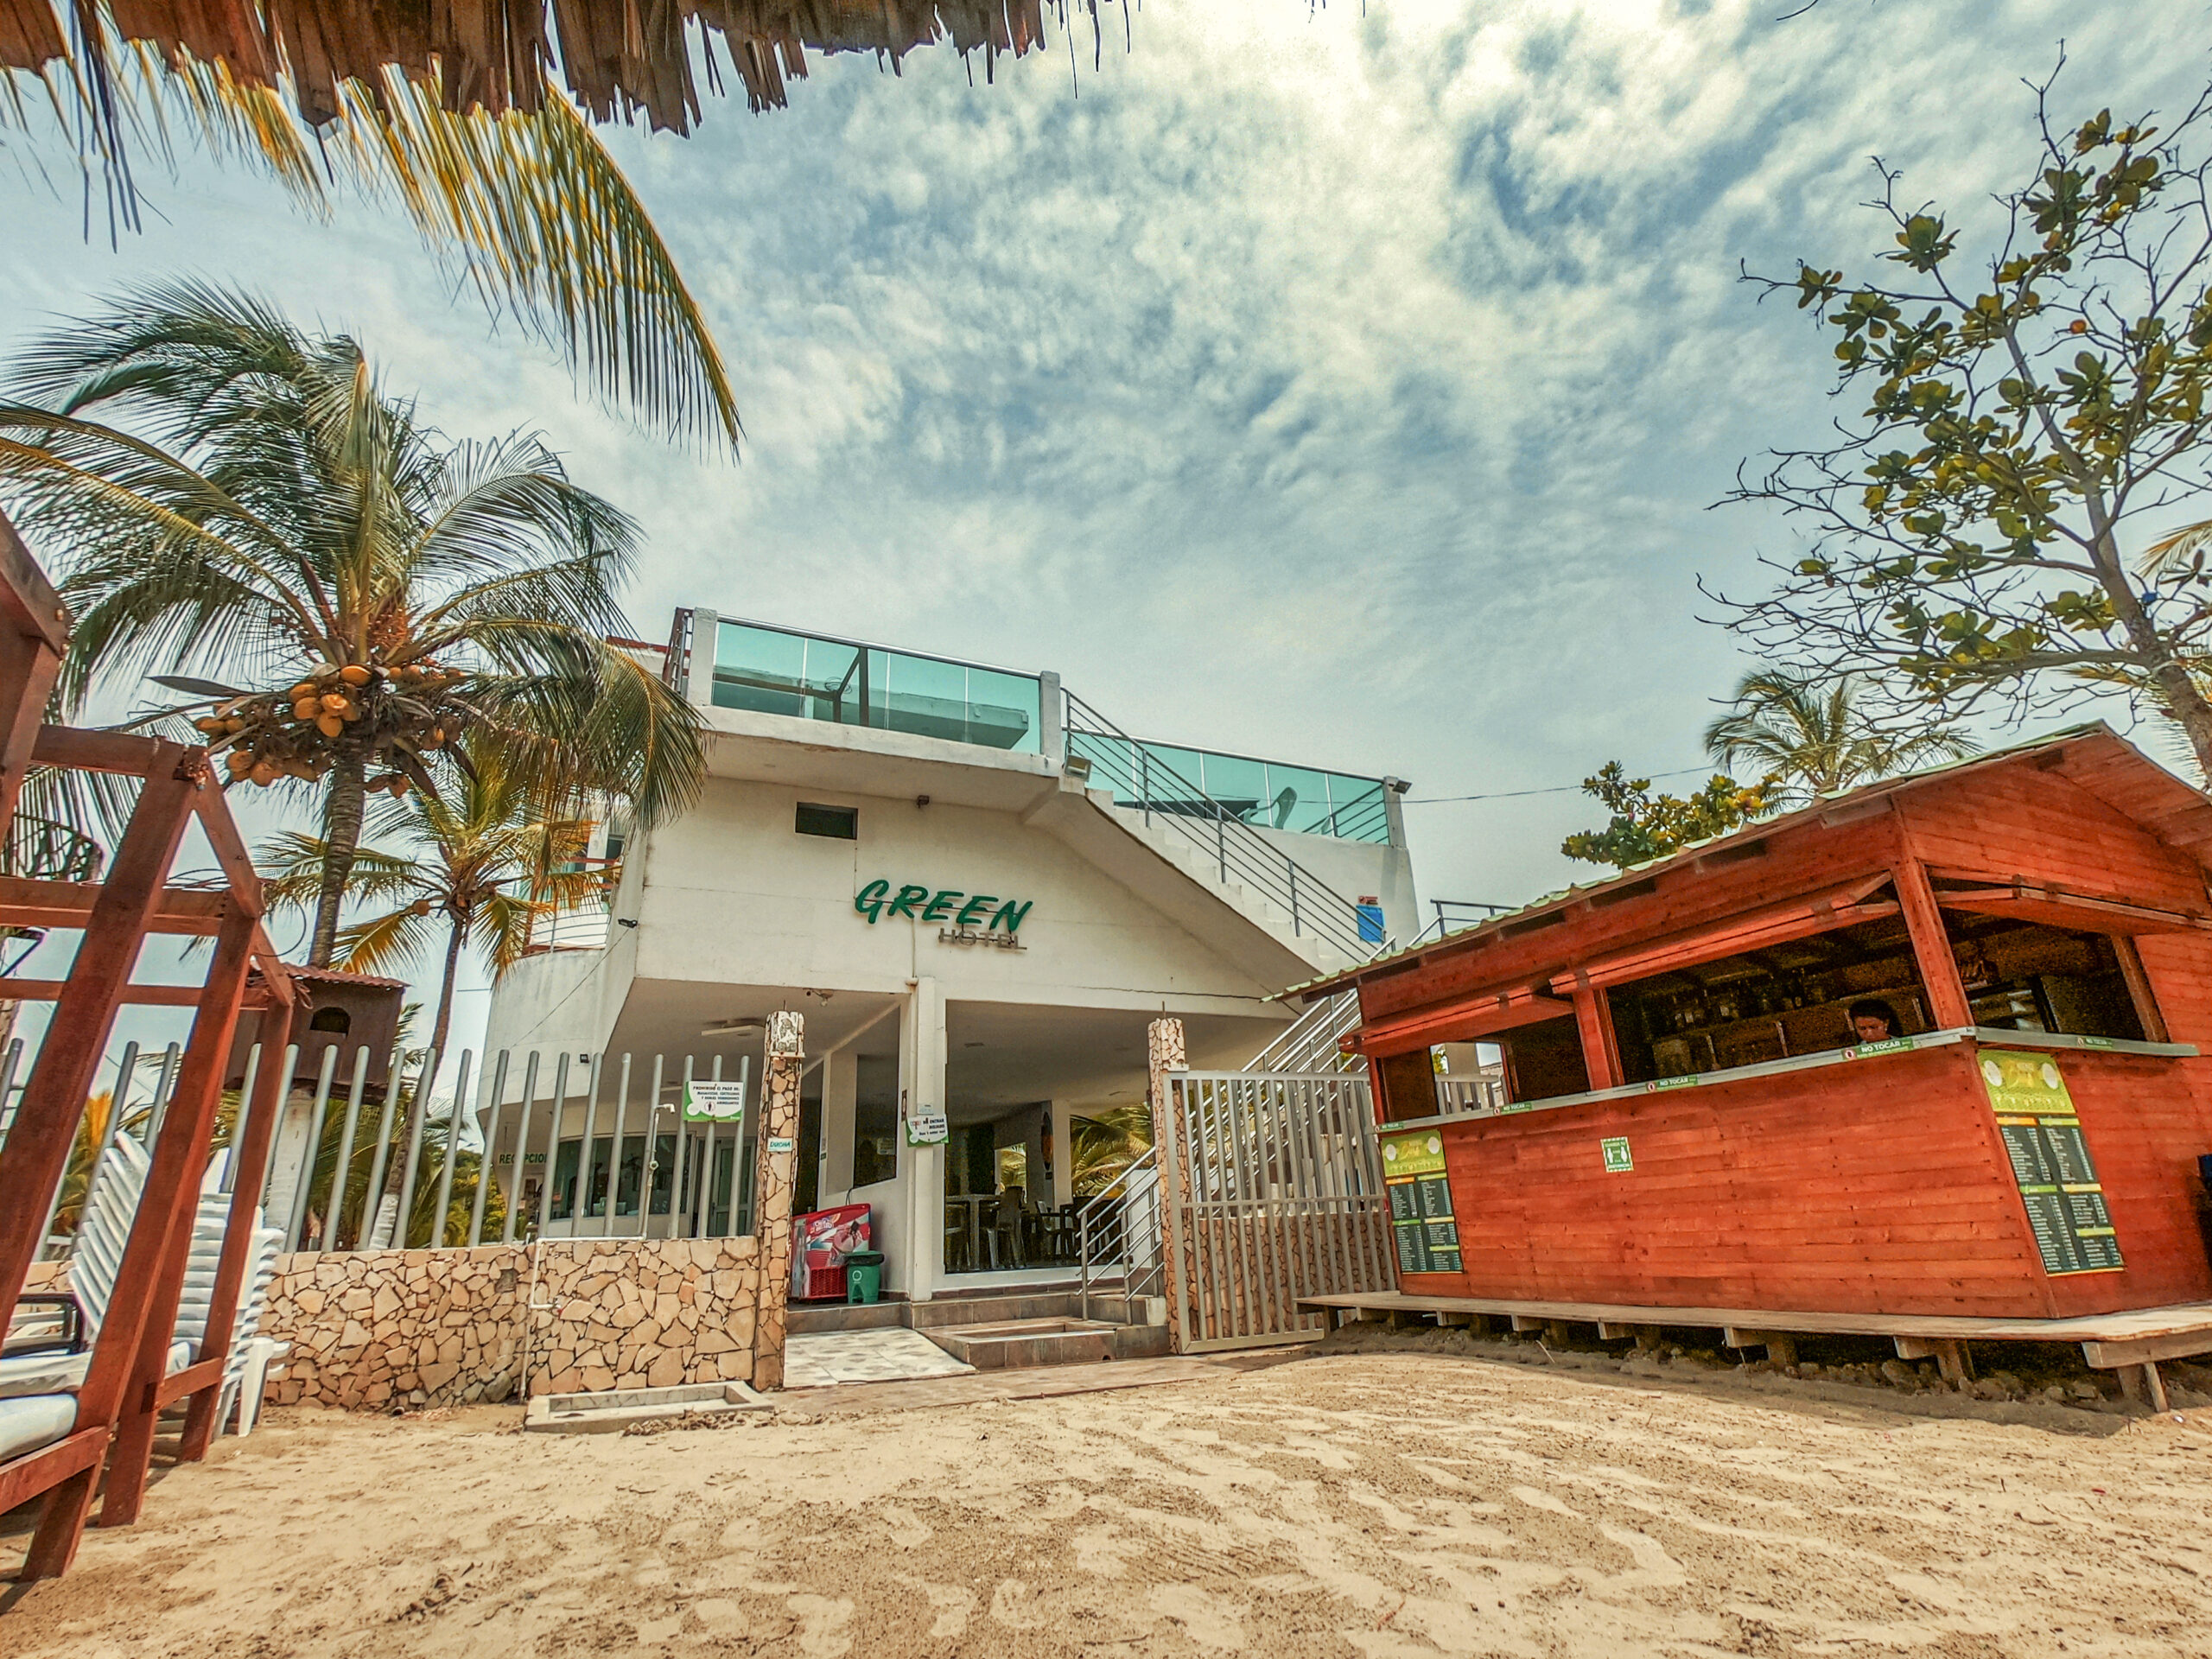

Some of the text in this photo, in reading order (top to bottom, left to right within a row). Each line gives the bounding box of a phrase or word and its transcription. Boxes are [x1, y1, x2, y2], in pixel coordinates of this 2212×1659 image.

[855, 880, 1033, 931] GREEN
[938, 928, 1027, 950] HOTEL
[1874, 1040, 1900, 1051] TOCAR
[499, 1154, 549, 1164] RECPCIO
